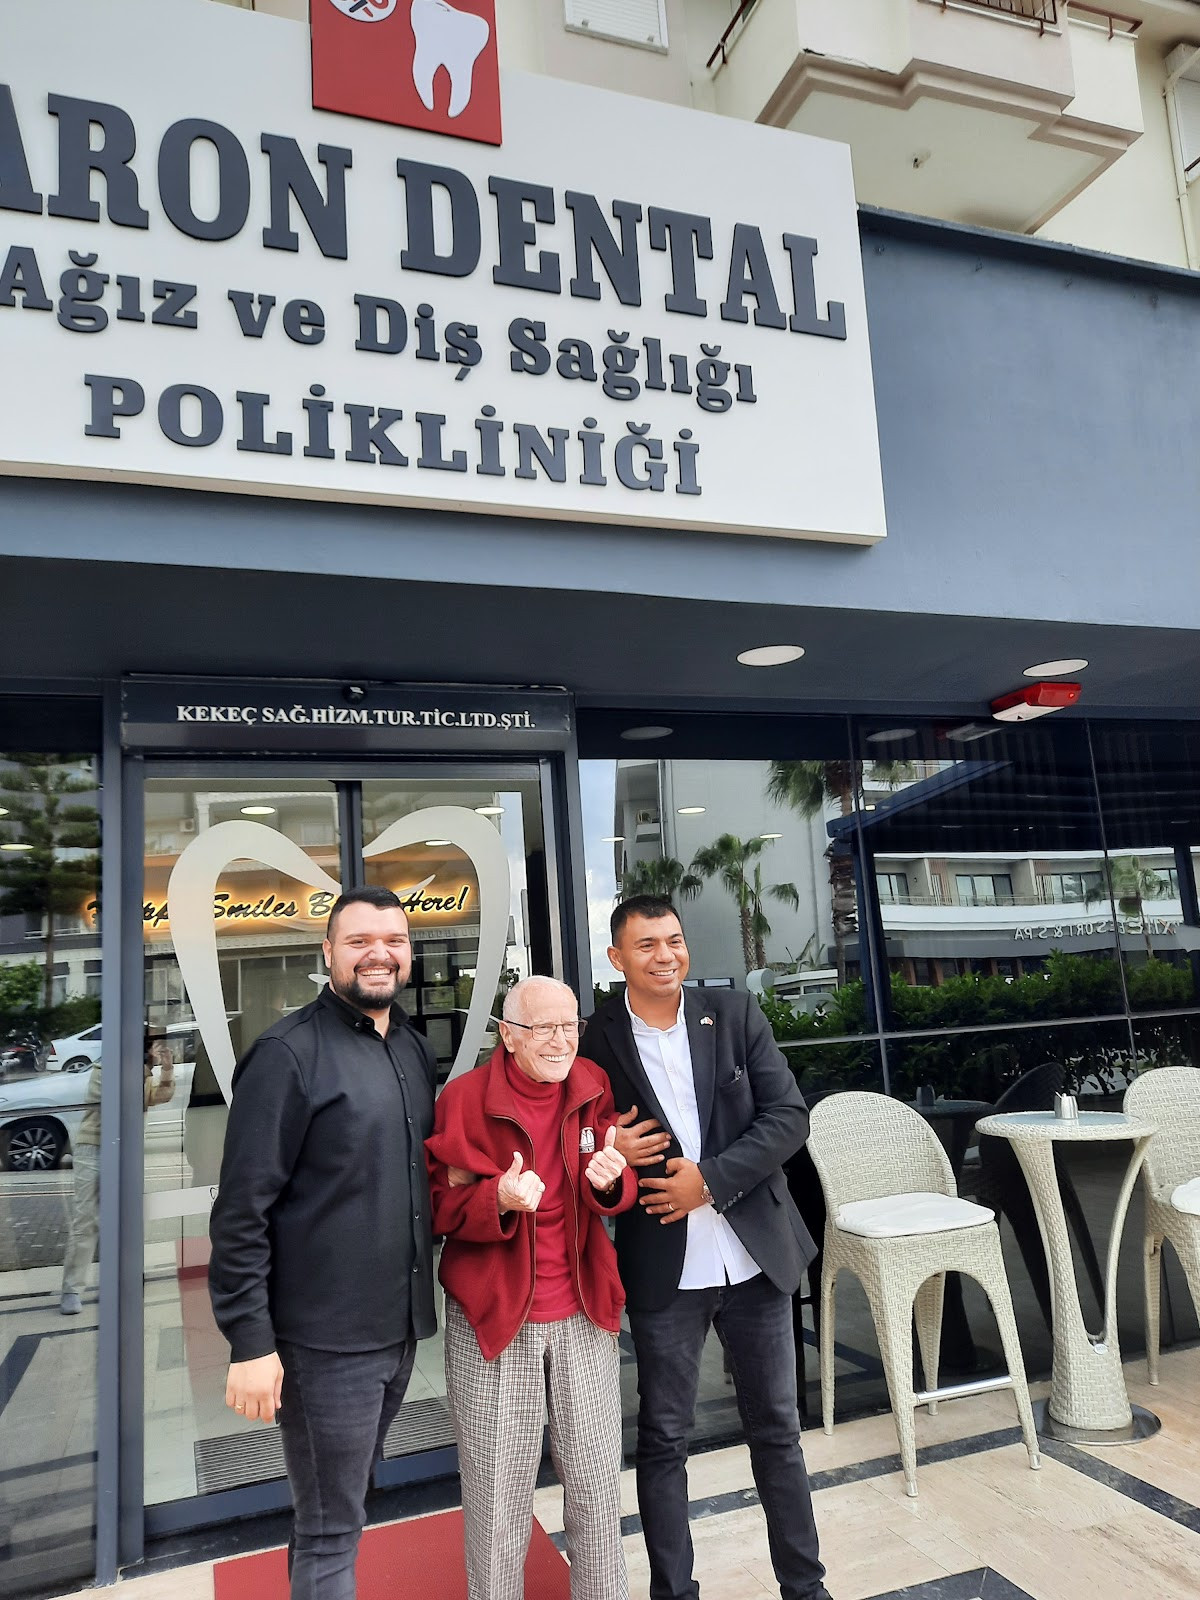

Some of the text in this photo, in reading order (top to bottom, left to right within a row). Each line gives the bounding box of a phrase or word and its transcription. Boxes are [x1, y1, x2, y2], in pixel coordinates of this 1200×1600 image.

[397, 158, 847, 340] DENTAL
[0, 245, 757, 413] Ağız ve Diş Sağlığı
[84, 373, 702, 496] POLİKLİNİĞİ
[176, 705, 257, 726] KEKEÇ
[213, 893, 299, 918] Smiles
[400, 886, 469, 913] Here!
